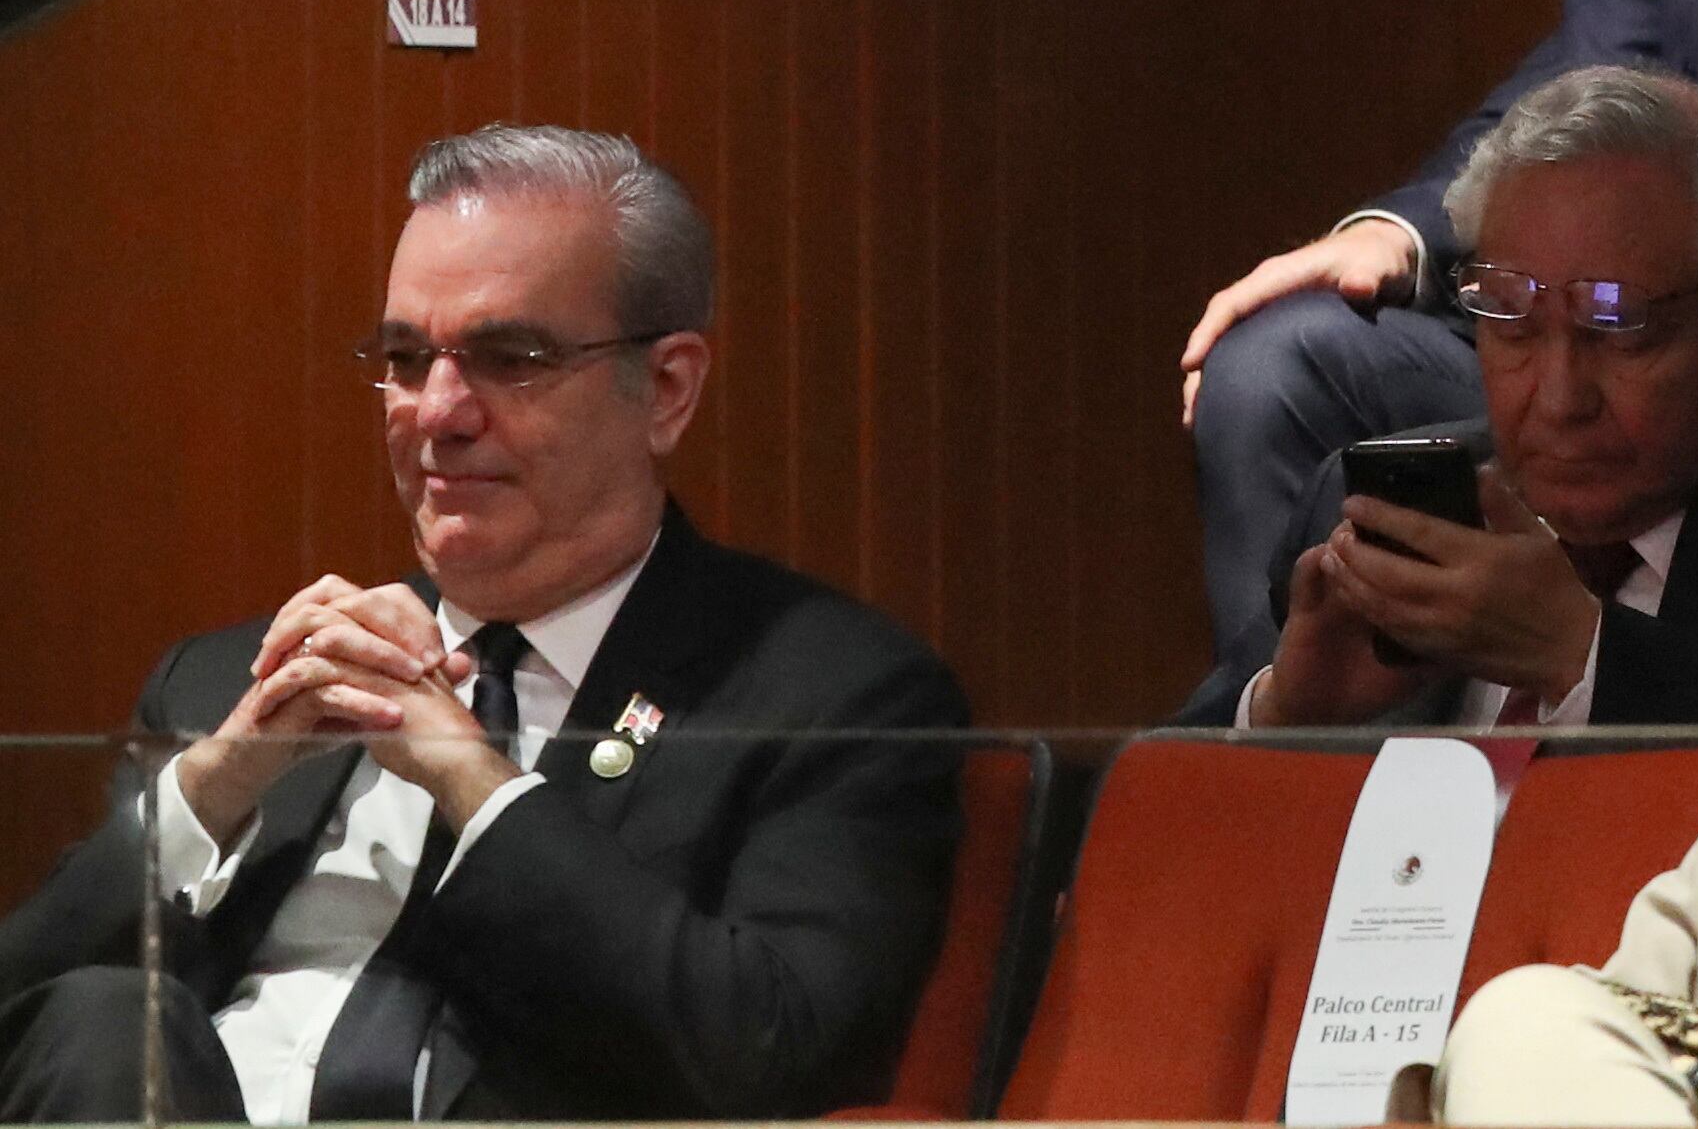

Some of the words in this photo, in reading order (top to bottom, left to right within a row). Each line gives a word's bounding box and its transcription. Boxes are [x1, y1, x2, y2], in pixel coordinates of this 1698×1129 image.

[1312, 996, 1365, 1014] Palco
[1371, 994, 1444, 1013] Central
[1320, 1025, 1357, 1043] Fila
[1362, 1025, 1376, 1042] A
[1395, 1024, 1421, 1041] 15
